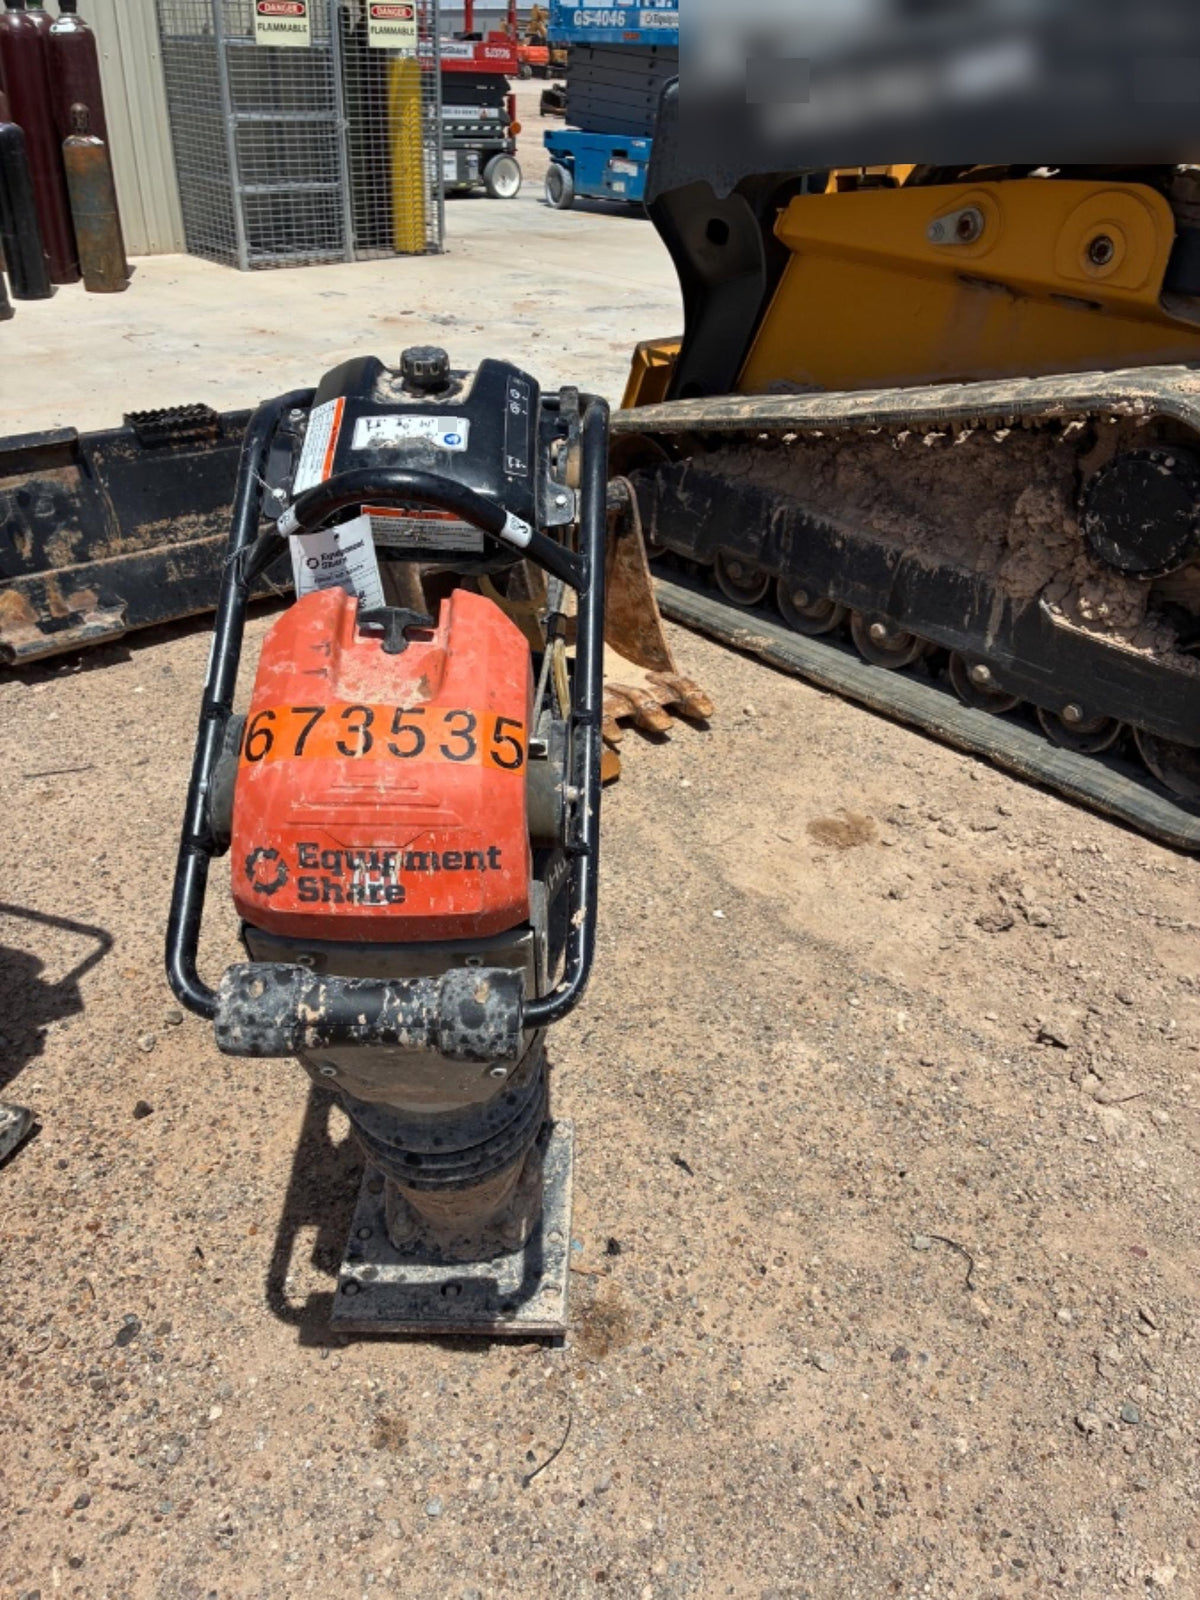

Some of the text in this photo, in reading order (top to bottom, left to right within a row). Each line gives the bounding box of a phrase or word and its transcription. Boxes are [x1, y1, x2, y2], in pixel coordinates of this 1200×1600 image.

[264, 2, 298, 13] DANGER
[376, 8, 406, 17] DANGER
[573, 10, 626, 27] GS-4046
[257, 23, 307, 33] FLAMMABLE
[371, 26, 415, 36] FLAMMABLE
[244, 705, 524, 770] 673535
[296, 842, 502, 877] Equipment
[297, 876, 406, 905] Share
